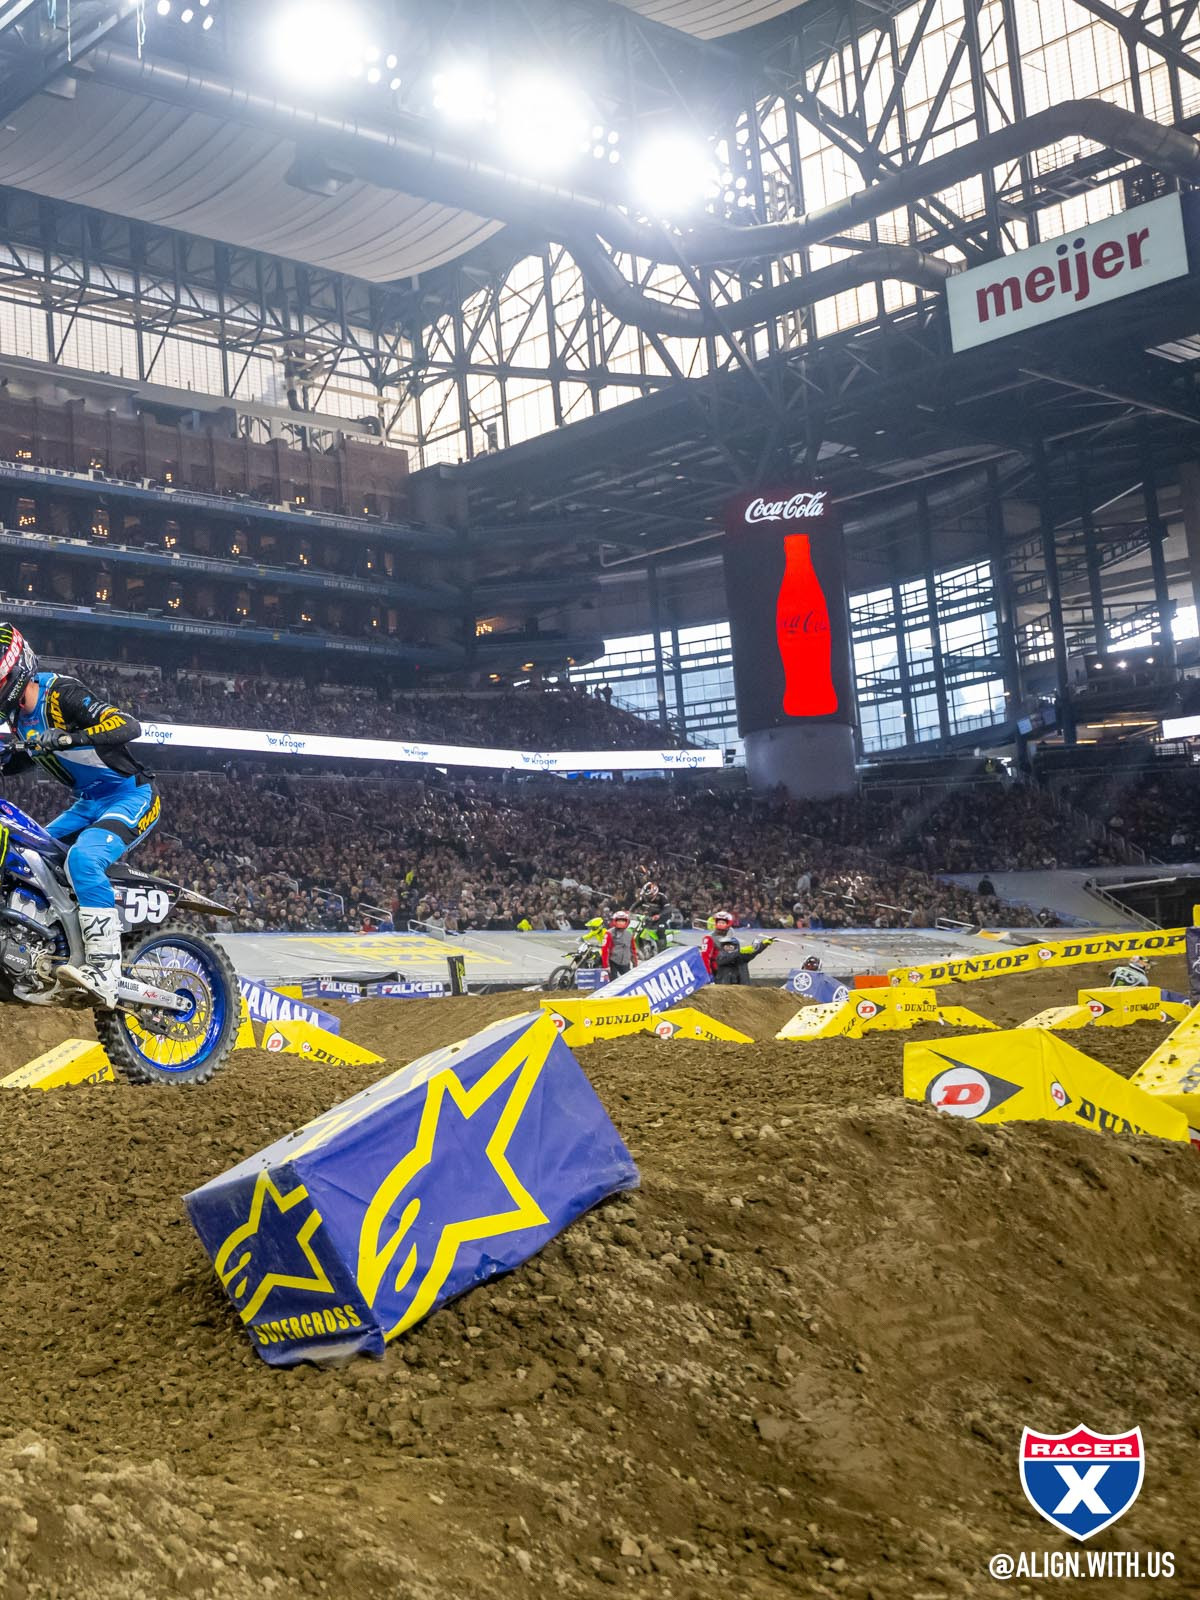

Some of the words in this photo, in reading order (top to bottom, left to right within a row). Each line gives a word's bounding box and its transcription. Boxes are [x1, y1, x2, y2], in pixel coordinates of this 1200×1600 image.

[976, 227, 1149, 323] meijer
[745, 491, 827, 523] Coca-Cola
[84, 714, 128, 736] THOR
[144, 724, 173, 744] Kroger
[279, 733, 306, 754] Kroger
[531, 752, 558, 771] Kroger
[675, 750, 706, 768] Kroger
[124, 888, 170, 924] 59
[1060, 934, 1186, 958] DUNLOP
[929, 954, 1029, 980] DUNLOP
[320, 982, 361, 994] FALKEN
[382, 982, 443, 994] FALKEN
[904, 1003, 937, 1013] DUNLOP
[595, 1012, 650, 1026] DUNLOP
[253, 1304, 361, 1345] SUPERCROSS
